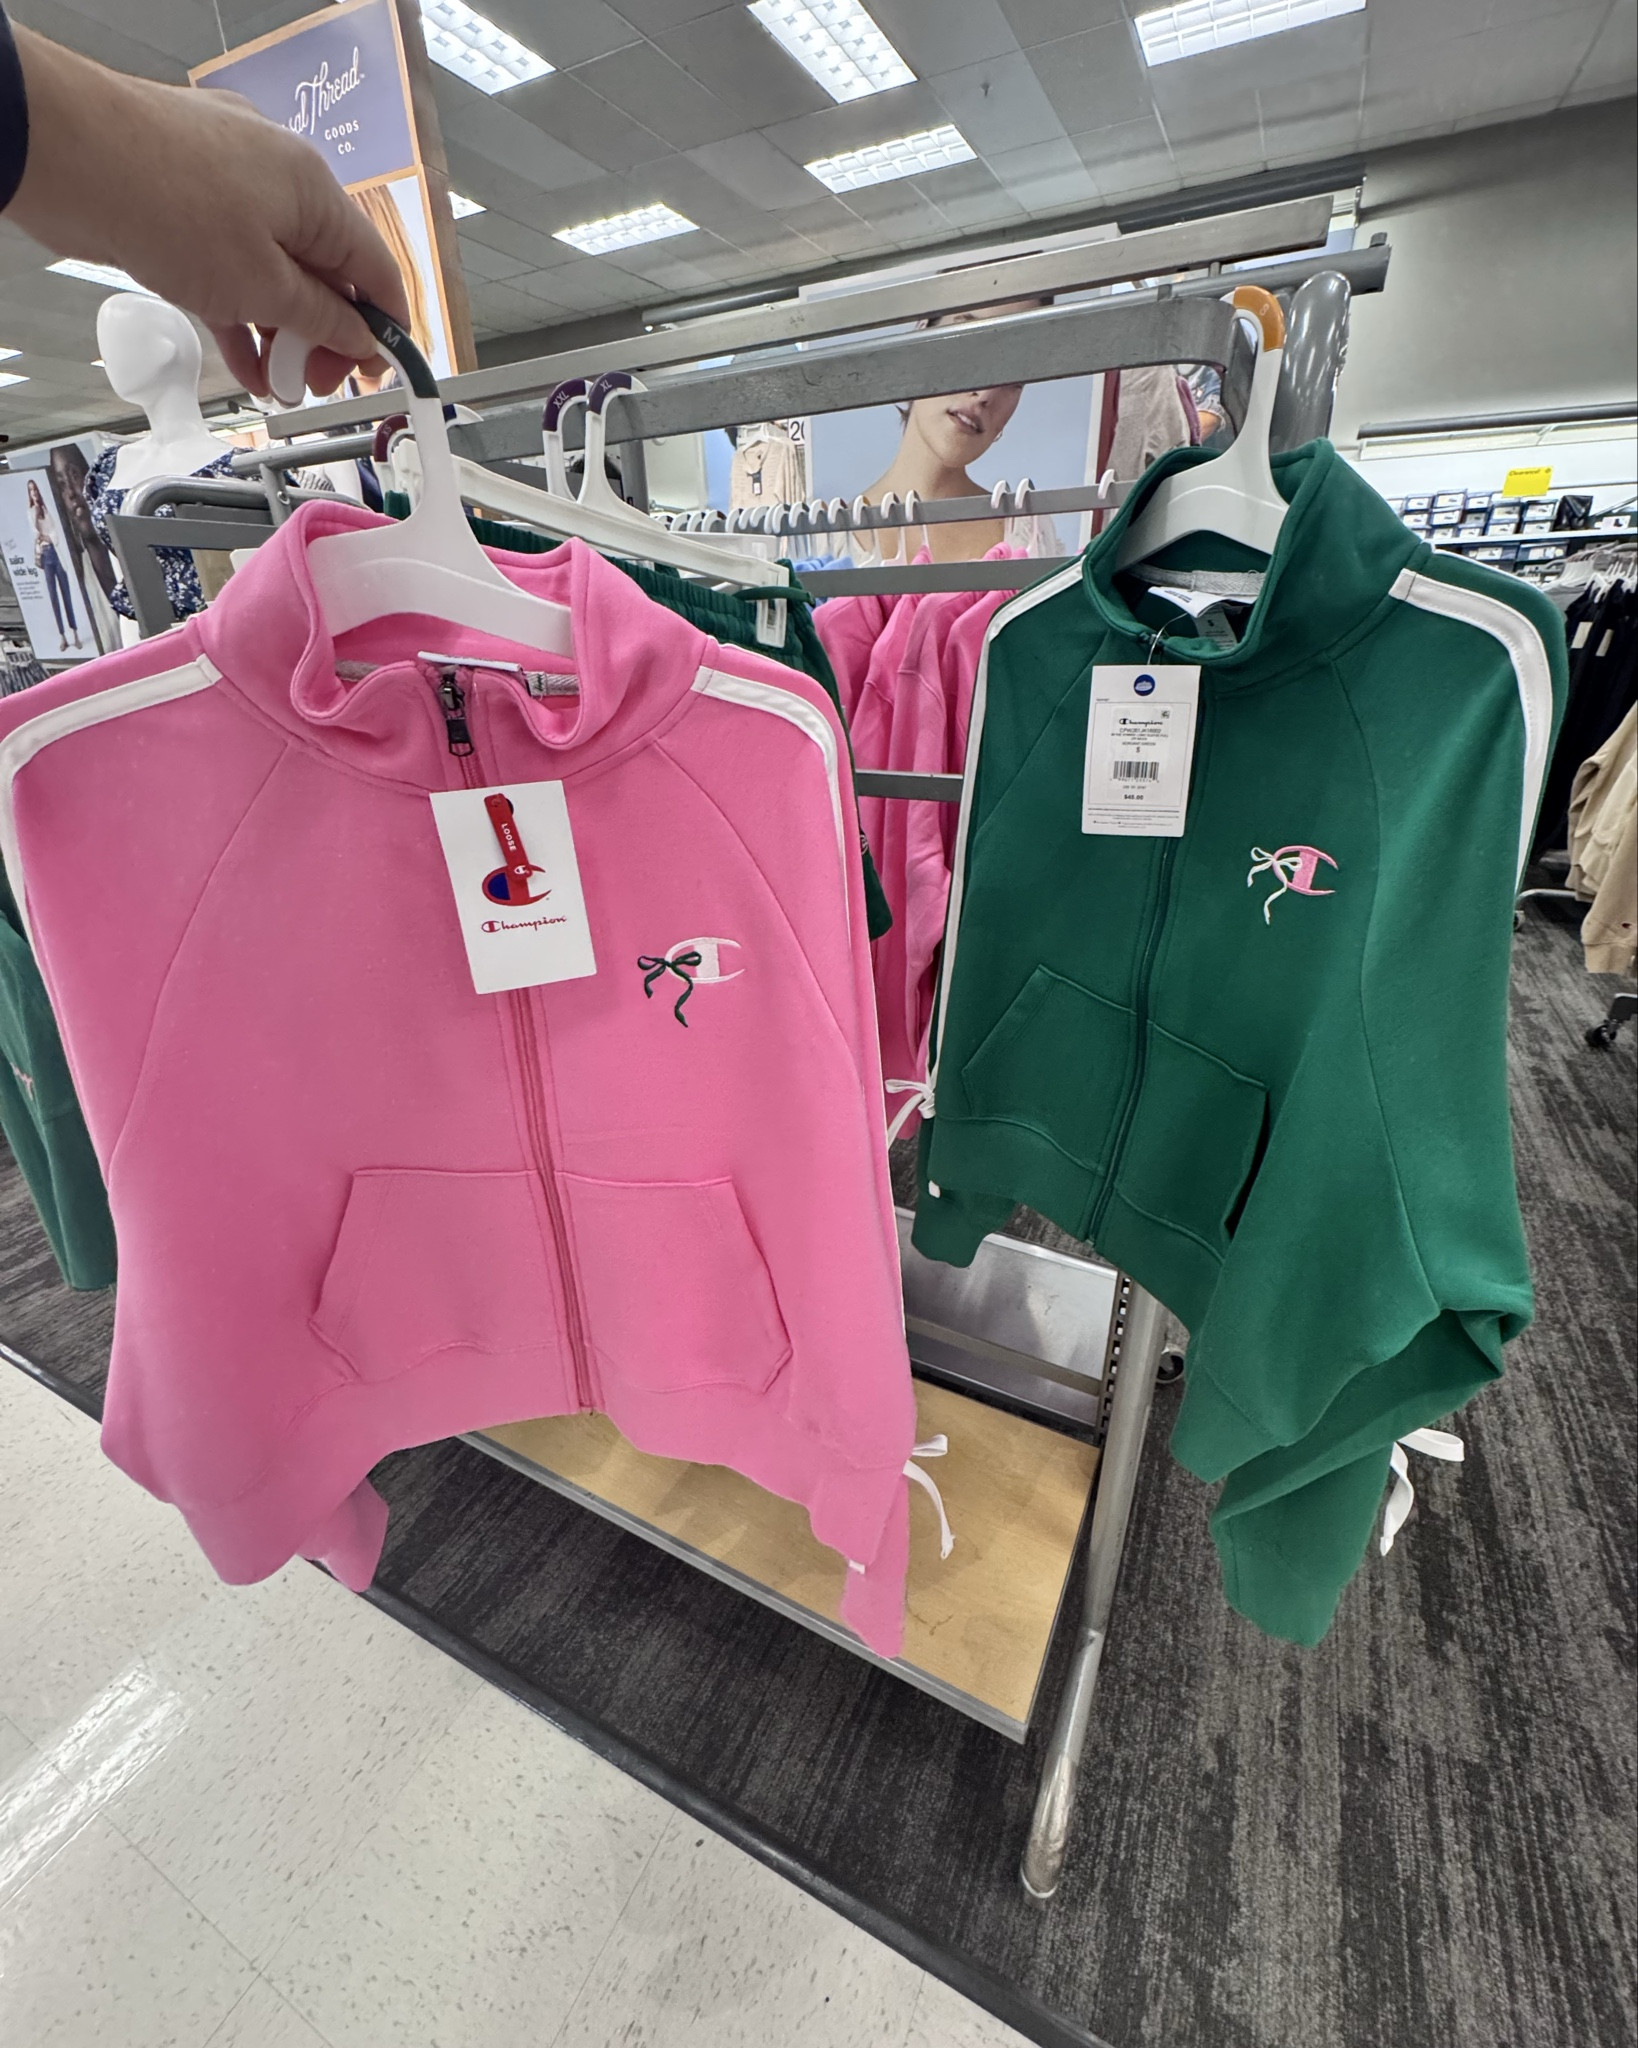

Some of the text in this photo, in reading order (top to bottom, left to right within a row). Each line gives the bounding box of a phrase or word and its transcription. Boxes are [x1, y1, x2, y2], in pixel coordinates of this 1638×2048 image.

[295, 46, 360, 135] Thread
[324, 120, 360, 141] GOODS
[337, 141, 356, 155] CO.
[382, 326, 401, 348] M
[600, 379, 612, 392] XL
[553, 391, 570, 409] XXL
[381, 424, 392, 438] XS
[1119, 718, 1163, 727] Champion
[501, 822, 516, 851] LOOSE
[481, 914, 567, 934] Champion
